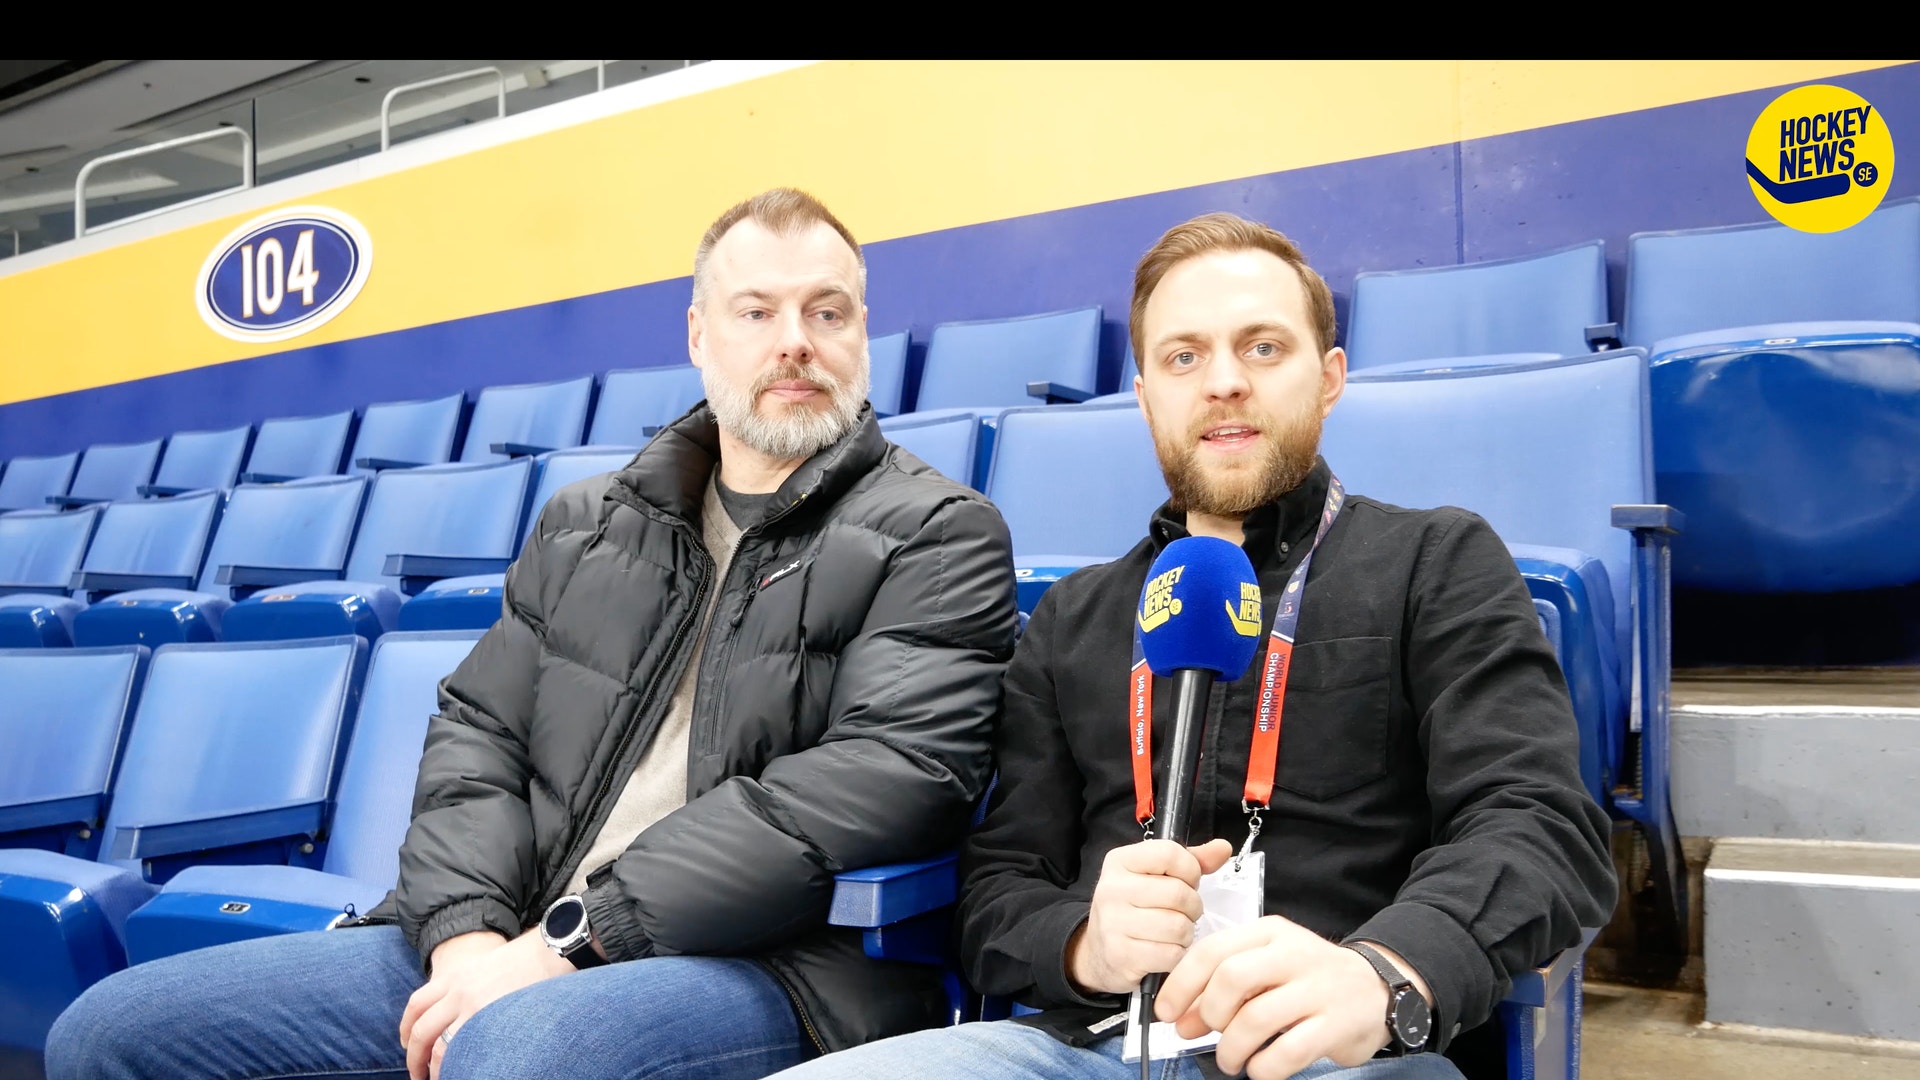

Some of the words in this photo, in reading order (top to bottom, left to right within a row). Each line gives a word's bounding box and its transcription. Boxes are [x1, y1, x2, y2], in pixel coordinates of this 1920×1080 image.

[241, 229, 319, 319] 104
[1145, 564, 1186, 601] HOCKEY
[1143, 586, 1173, 620] NEWS
[1136, 673, 1145, 695] York
[1273, 653, 1287, 689] WORLD
[1136, 696, 1144, 718] New
[1258, 652, 1279, 733] CHAMPIONSHIP
[1267, 691, 1280, 731] JUNIOR
[1136, 719, 1145, 756] Buffalo,
